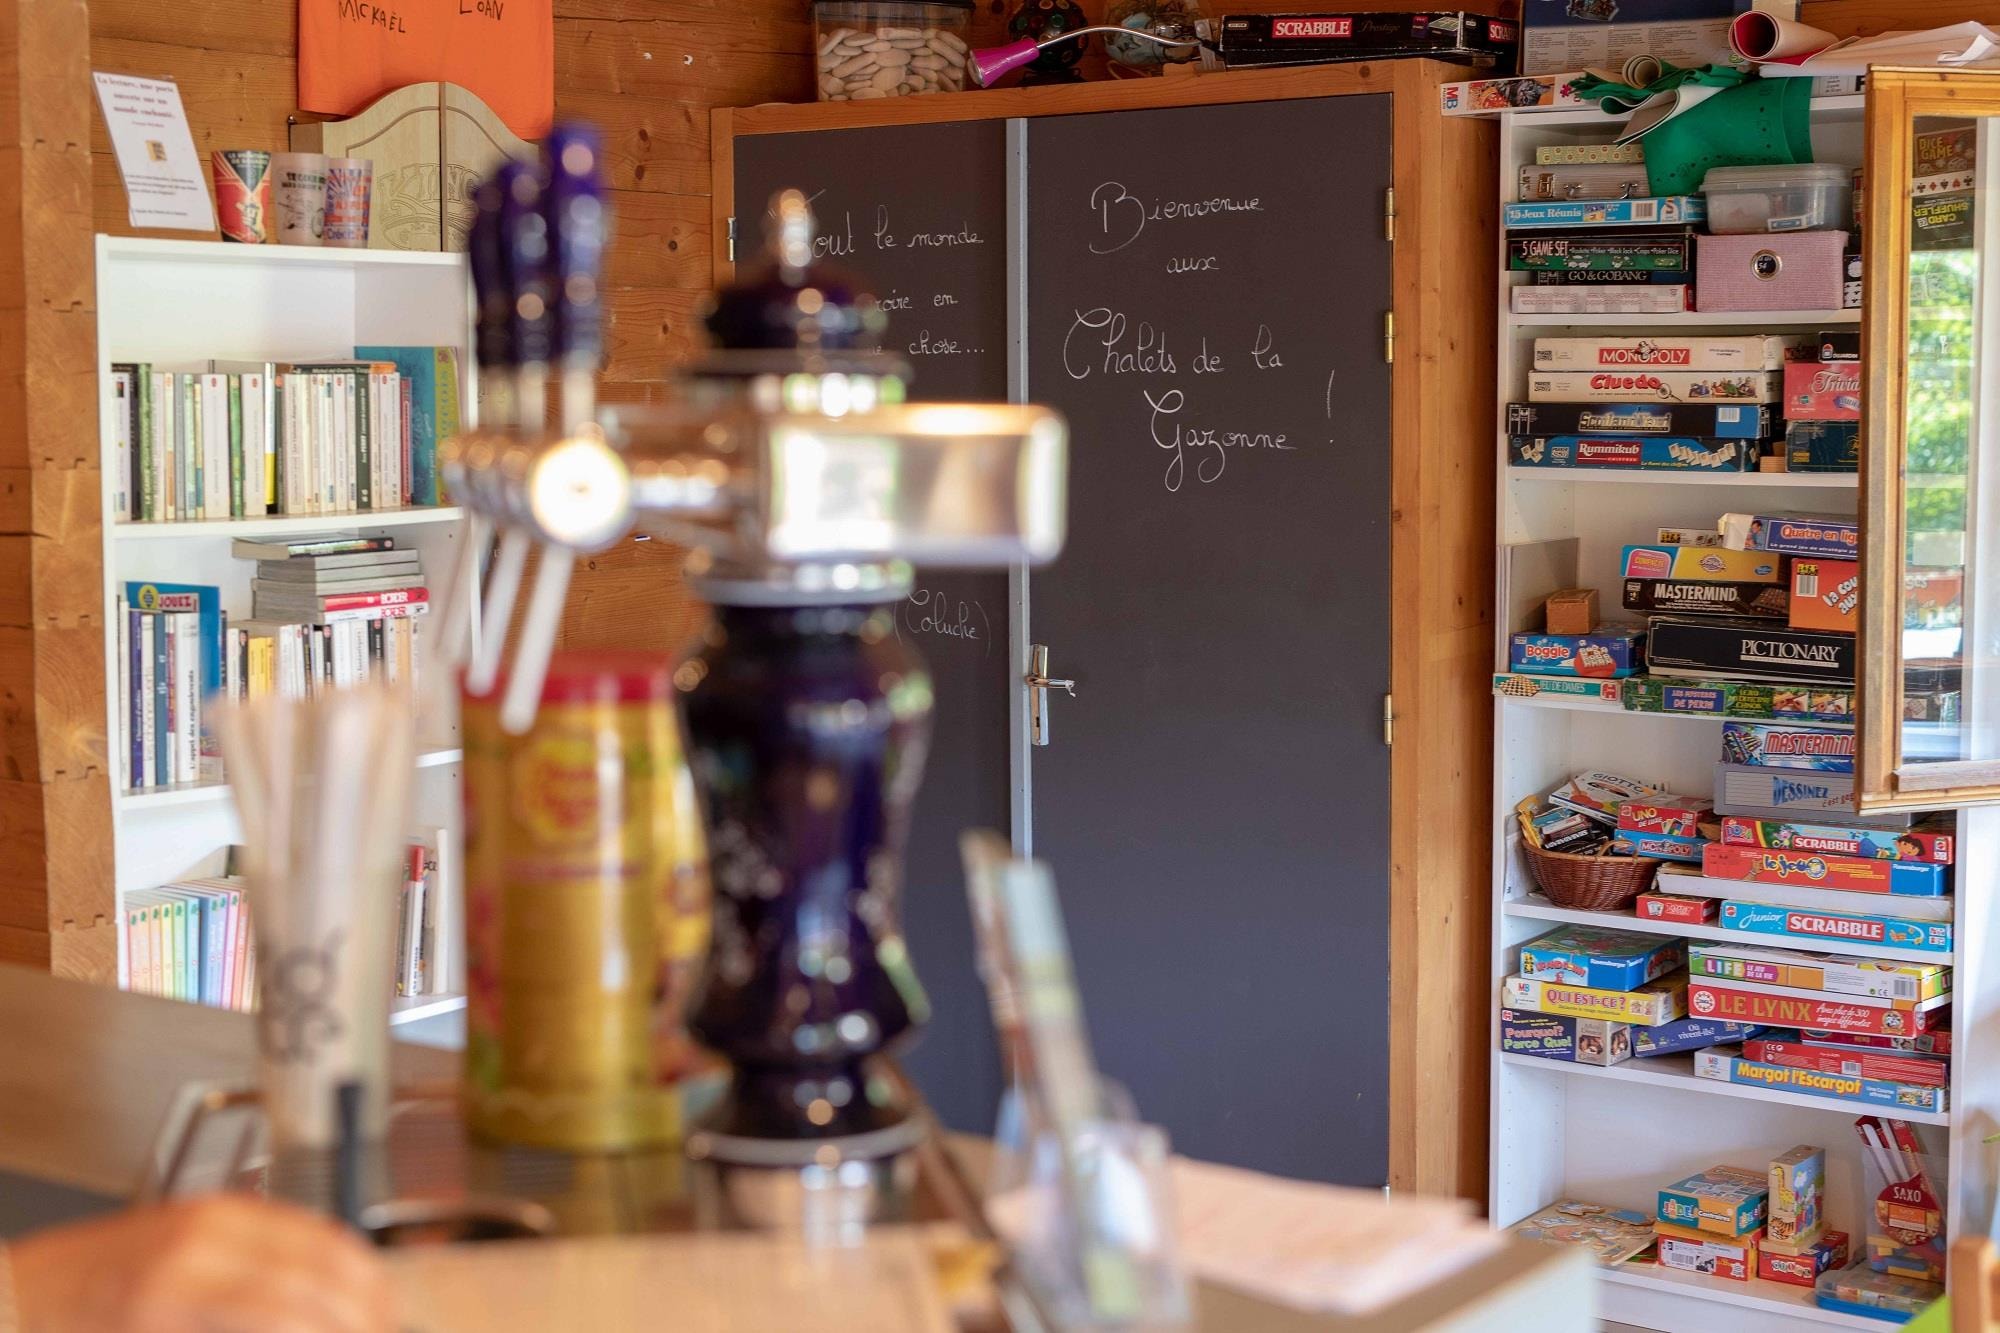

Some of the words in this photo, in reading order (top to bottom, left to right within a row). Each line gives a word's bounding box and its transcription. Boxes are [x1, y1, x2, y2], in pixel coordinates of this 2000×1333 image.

[1275, 19, 1351, 36] SCRABBLE
[1446, 86, 1459, 110] MB
[1919, 136, 1944, 150] DICE
[1921, 144, 1953, 160] GAME
[1089, 181, 1265, 254] Bienvenue
[1521, 209, 1545, 219] Jeux
[1547, 207, 1581, 218] Réunis
[1913, 202, 1969, 217] SHUFFLER
[874, 204, 897, 250] le
[906, 220, 985, 248] monde
[1927, 214, 1957, 225] CARD
[1522, 241, 1528, 256] 5
[1530, 241, 1554, 256] GAME
[1555, 240, 1569, 256] SET
[1166, 255, 1221, 274] aux
[1568, 271, 1587, 281] GO
[1597, 271, 1648, 281] GOBANG
[876, 289, 913, 312] roire
[933, 294, 958, 307] en
[1063, 307, 1177, 379] Chalets
[1192, 336, 1226, 374] de
[1251, 323, 1285, 370] la
[1601, 349, 1686, 364] MONOPOLY
[1590, 374, 1661, 390] Cluedo
[1810, 370, 1860, 394] Trivia
[1143, 389, 1298, 492] Gazonne
[1578, 443, 1640, 456] Rummikub
[1781, 524, 1822, 539] Quatre
[1823, 530, 1839, 541] en
[1840, 529, 1858, 546] lig
[1654, 583, 1738, 602] MASTERMIND
[1525, 645, 1570, 658] Boggle
[1741, 639, 1841, 662] PICTIONARY
[1592, 772, 1644, 793] GIOTTO
[1772, 775, 1829, 806] DESSINEZ
[1632, 807, 1657, 822] UNO
[1794, 837, 1858, 852] SCRABBLE
[1789, 916, 1882, 938] SCRABBLE
[1706, 959, 1742, 977] LIFE
[1518, 983, 1530, 993] MB
[1547, 989, 1570, 1004] QUI
[1720, 994, 1747, 1016] LE
[1753, 997, 1812, 1022] LYNX
[1687, 1023, 1700, 1032] Où
[1503, 1038, 1540, 1050] Parce
[1737, 1062, 1790, 1085] Margot
[1791, 1069, 1863, 1096] l'Escargot
[1893, 1186, 1922, 1203] SAXO
